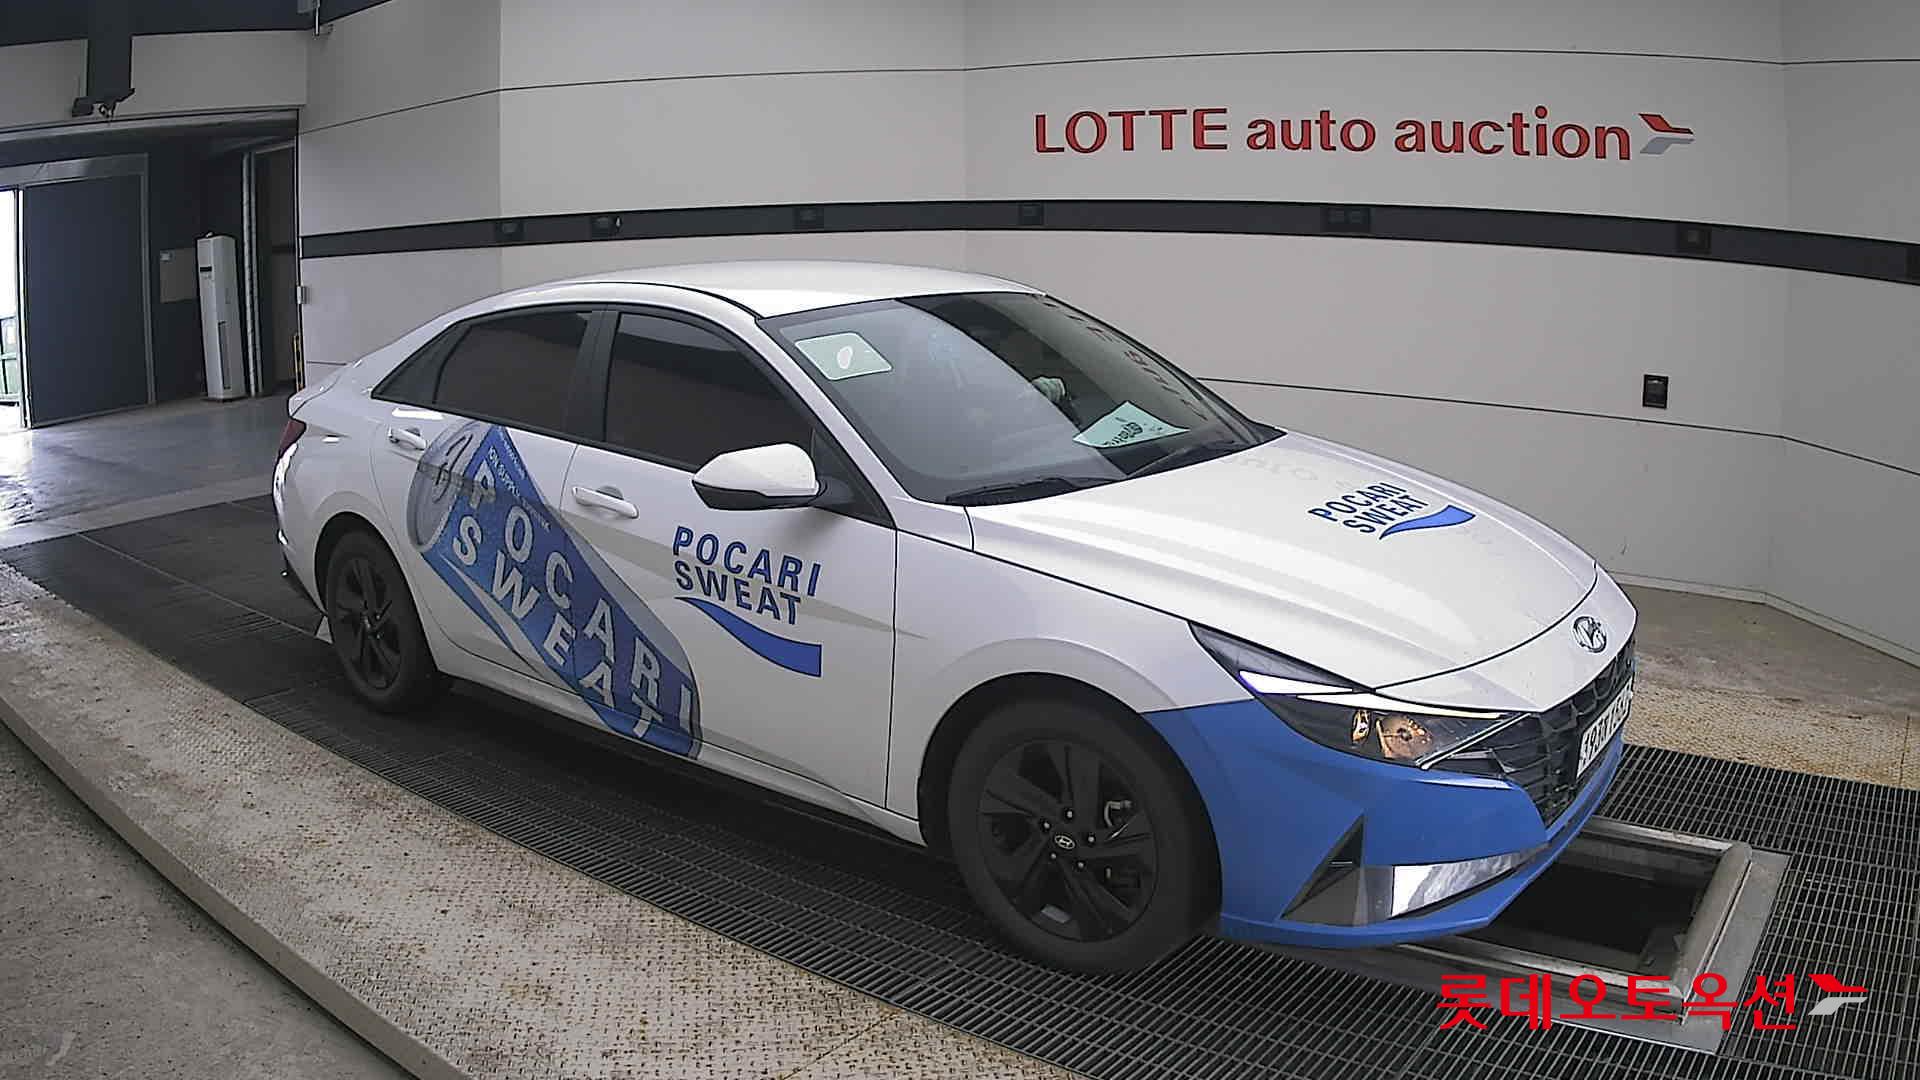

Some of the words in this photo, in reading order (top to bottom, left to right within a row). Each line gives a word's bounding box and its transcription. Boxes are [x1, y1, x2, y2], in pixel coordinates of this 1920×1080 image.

[1035, 108, 1228, 154] LOTTE
[1246, 110, 1376, 152] auto
[1395, 107, 1630, 160] auction
[1308, 482, 1407, 522] POCARI
[1342, 495, 1429, 534] SWEAT
[672, 526, 821, 597] POCARI
[674, 560, 801, 625] SWEAT
[452, 515, 663, 738] SWEAT
[470, 460, 693, 731] POCARI
